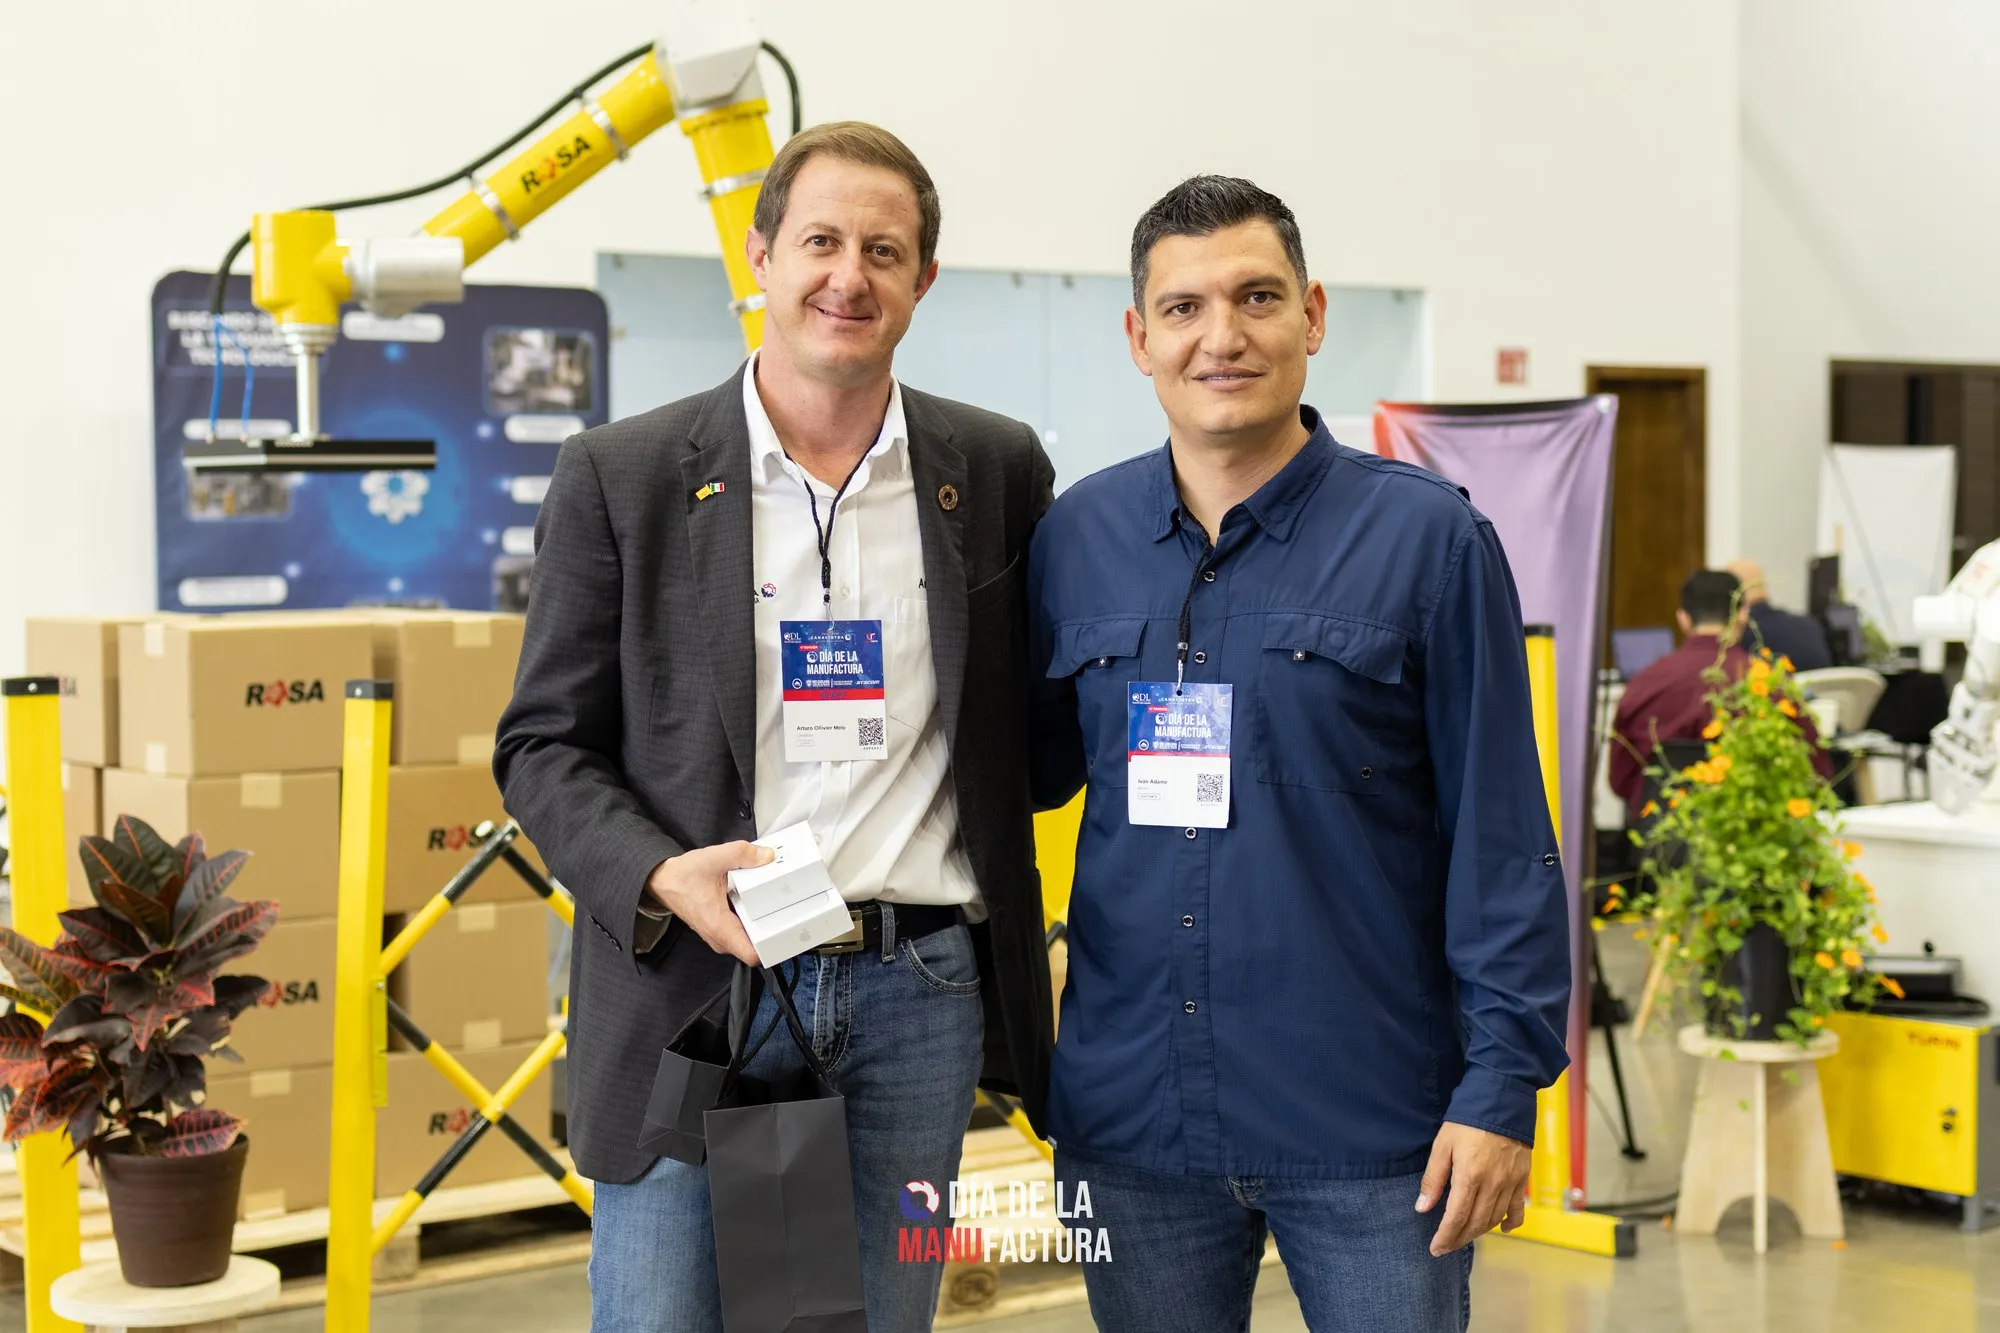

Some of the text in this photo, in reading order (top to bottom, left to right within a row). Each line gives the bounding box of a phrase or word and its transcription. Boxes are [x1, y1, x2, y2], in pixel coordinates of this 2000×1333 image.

[819, 648, 858, 663] DÍA DE LA
[806, 663, 864, 675] MANUFACTURA
[245, 677, 325, 708] ROSA
[1168, 712, 1207, 726] DÍA DE LA
[1154, 726, 1212, 738] MANUFACTURA
[257, 980, 319, 1009] OSA
